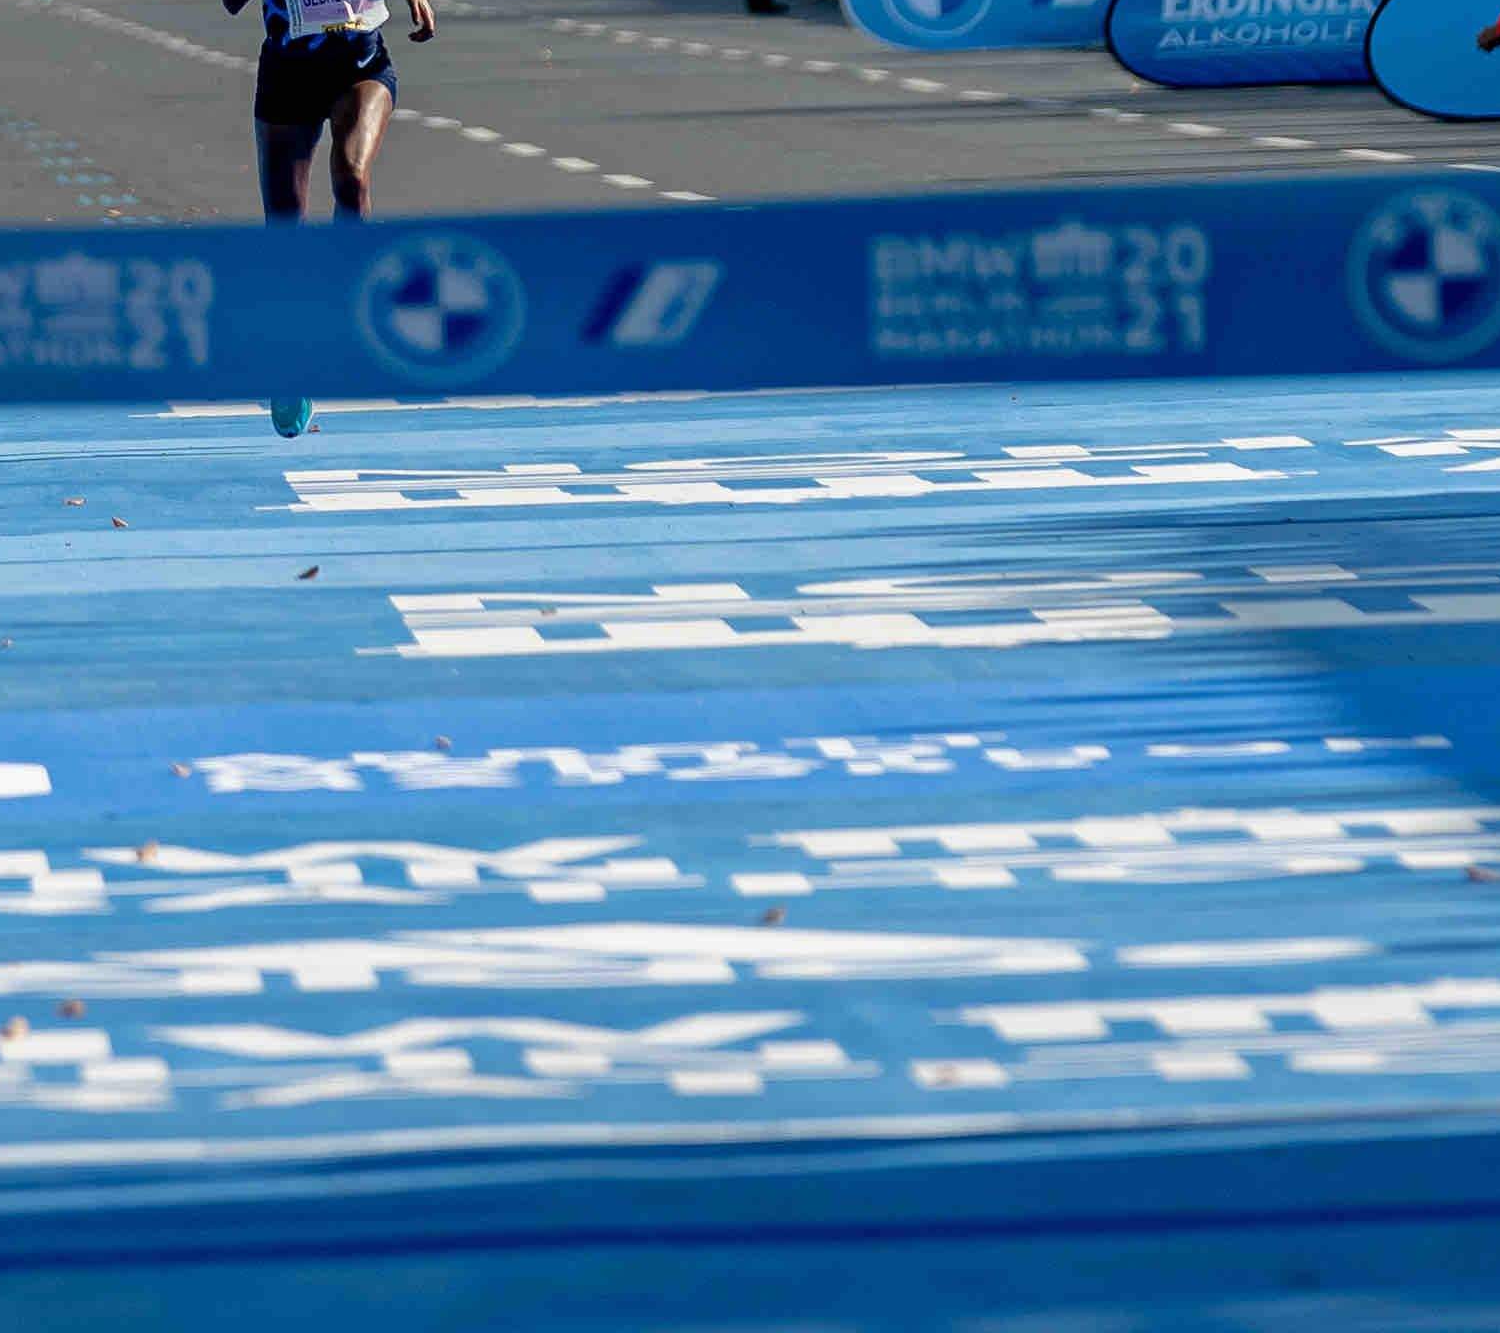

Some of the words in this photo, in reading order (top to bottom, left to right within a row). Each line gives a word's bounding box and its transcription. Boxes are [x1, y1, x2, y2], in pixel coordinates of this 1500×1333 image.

[120, 257, 213, 307] 20
[1118, 226, 1210, 285] 20
[121, 307, 208, 369] 21
[1118, 287, 1208, 350] 21
